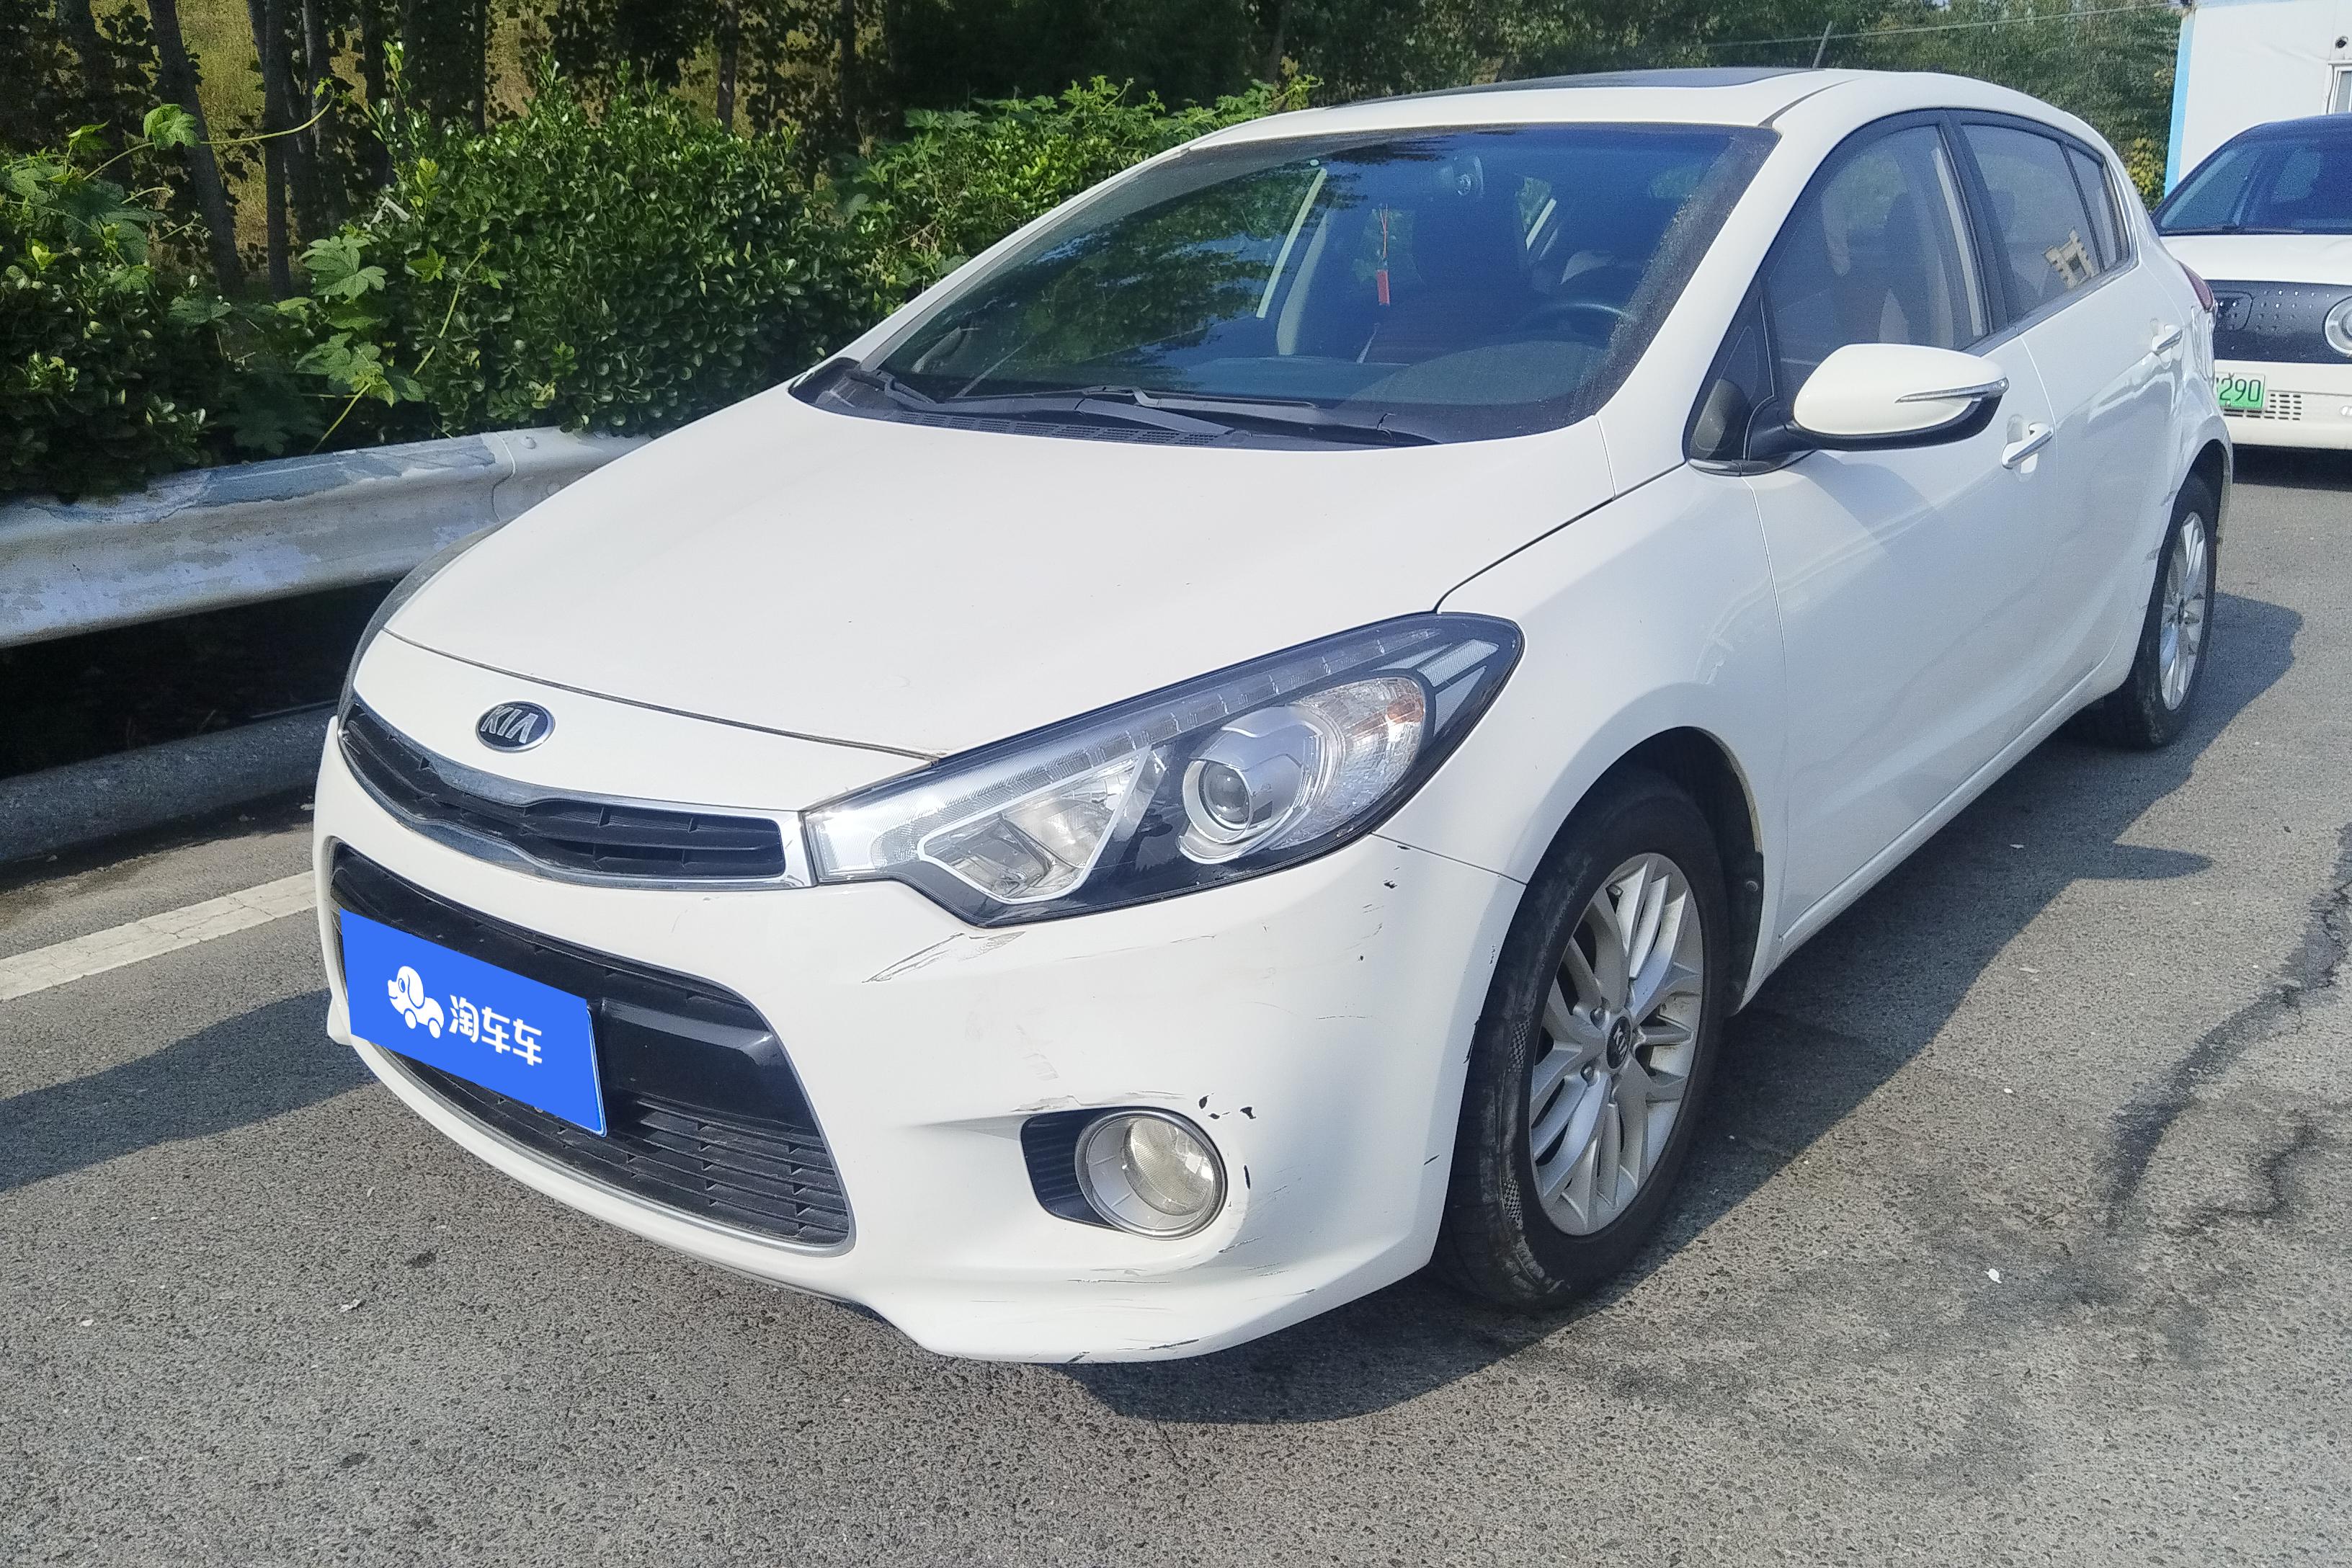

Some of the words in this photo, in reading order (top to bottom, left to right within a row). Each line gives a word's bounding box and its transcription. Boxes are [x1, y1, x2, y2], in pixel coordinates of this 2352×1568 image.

[2217, 378, 2261, 402] 290
[480, 705, 538, 744] KIA
[1613, 1025, 1628, 1061] KIA
